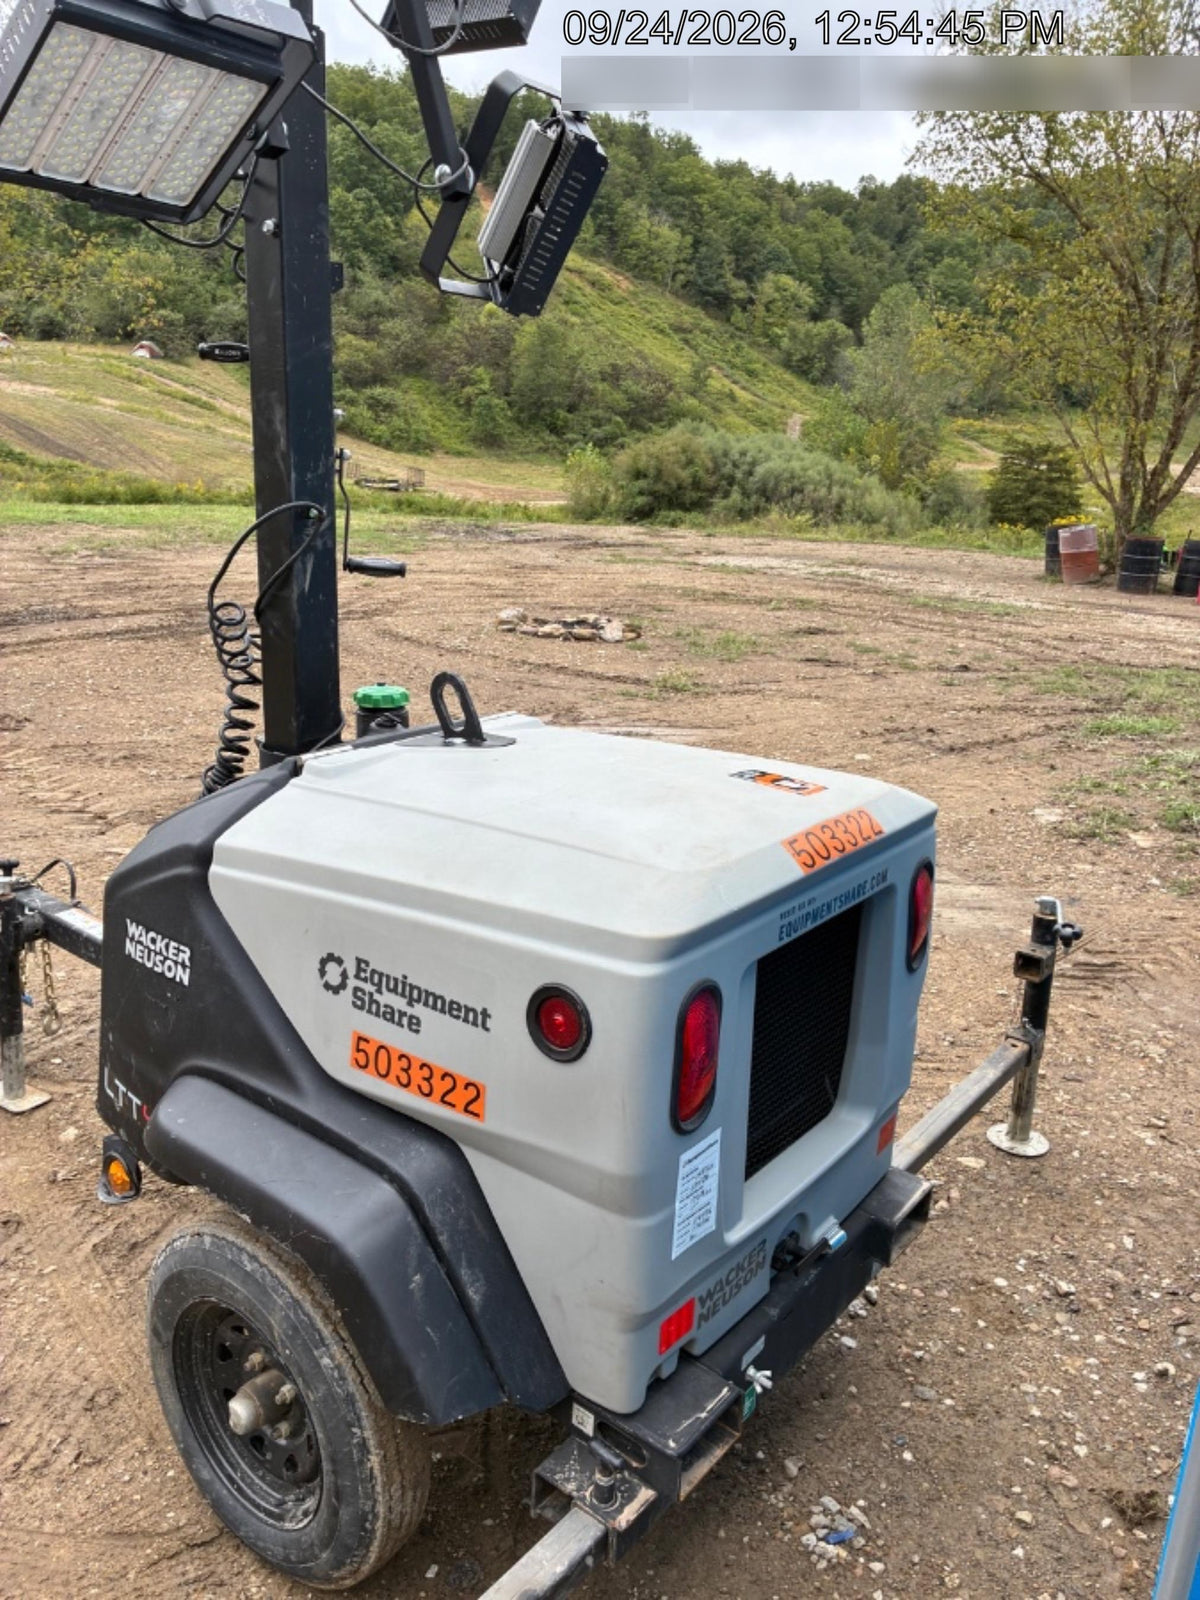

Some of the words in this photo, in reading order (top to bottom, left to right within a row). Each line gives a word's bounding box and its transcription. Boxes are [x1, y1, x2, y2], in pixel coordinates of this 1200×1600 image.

[786, 809, 885, 869] 503322
[778, 867, 889, 942] EQUIPMENTSHARE.COM
[125, 918, 191, 967] WACKER
[125, 936, 191, 986] NEUSON
[351, 985, 422, 1035] Share
[353, 956, 492, 1033] Equipment
[354, 1034, 481, 1119] 503322
[696, 1252, 767, 1331] NEUSON
[698, 1237, 768, 1309] WACKER
